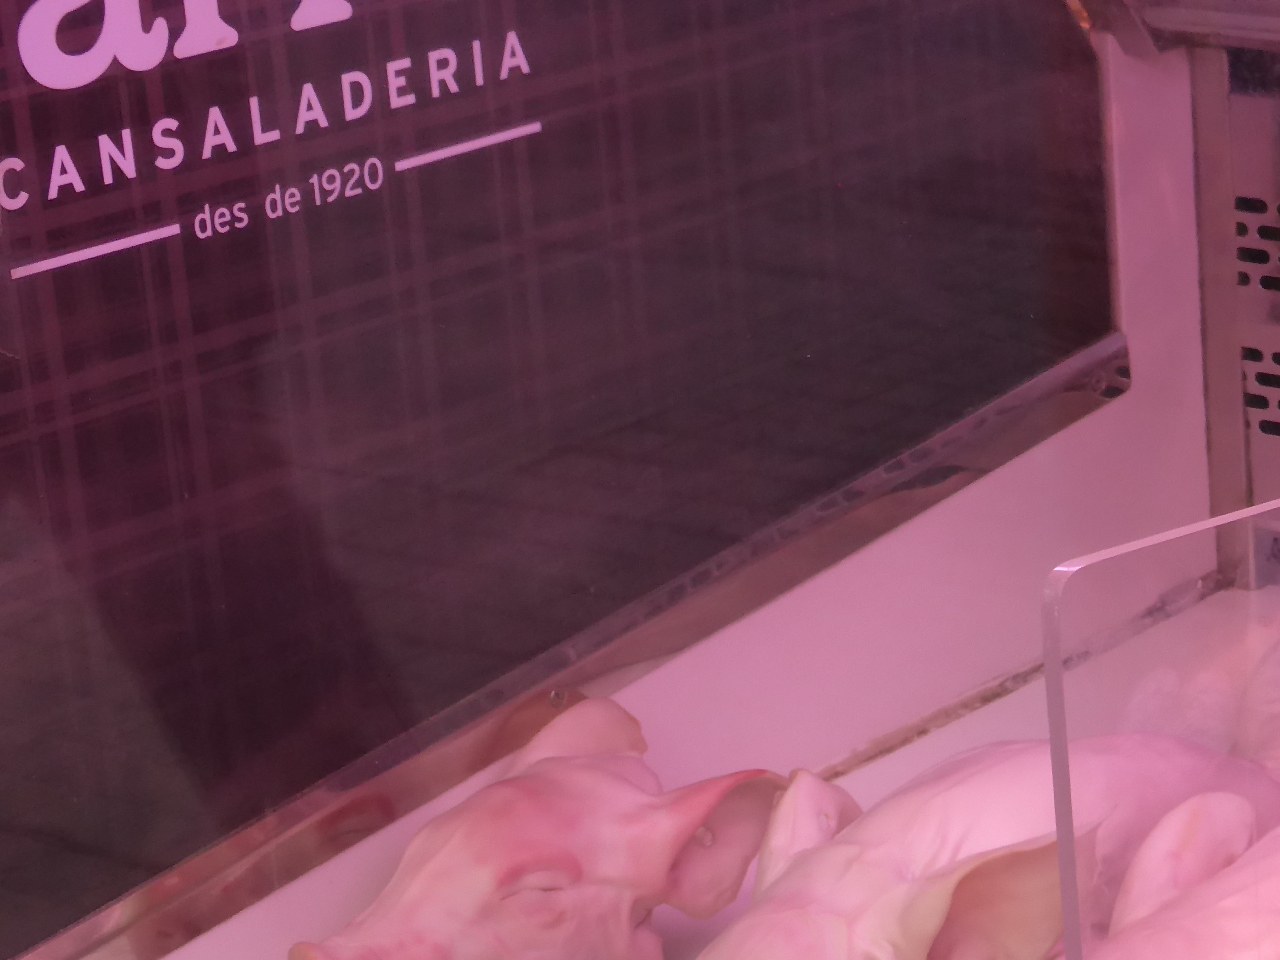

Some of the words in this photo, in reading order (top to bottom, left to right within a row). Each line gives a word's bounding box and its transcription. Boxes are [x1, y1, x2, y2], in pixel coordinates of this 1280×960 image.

[0, 31, 531, 210] CANSALADERIA
[194, 199, 249, 239] des
[264, 184, 301, 220] de
[308, 157, 384, 206] 1920
